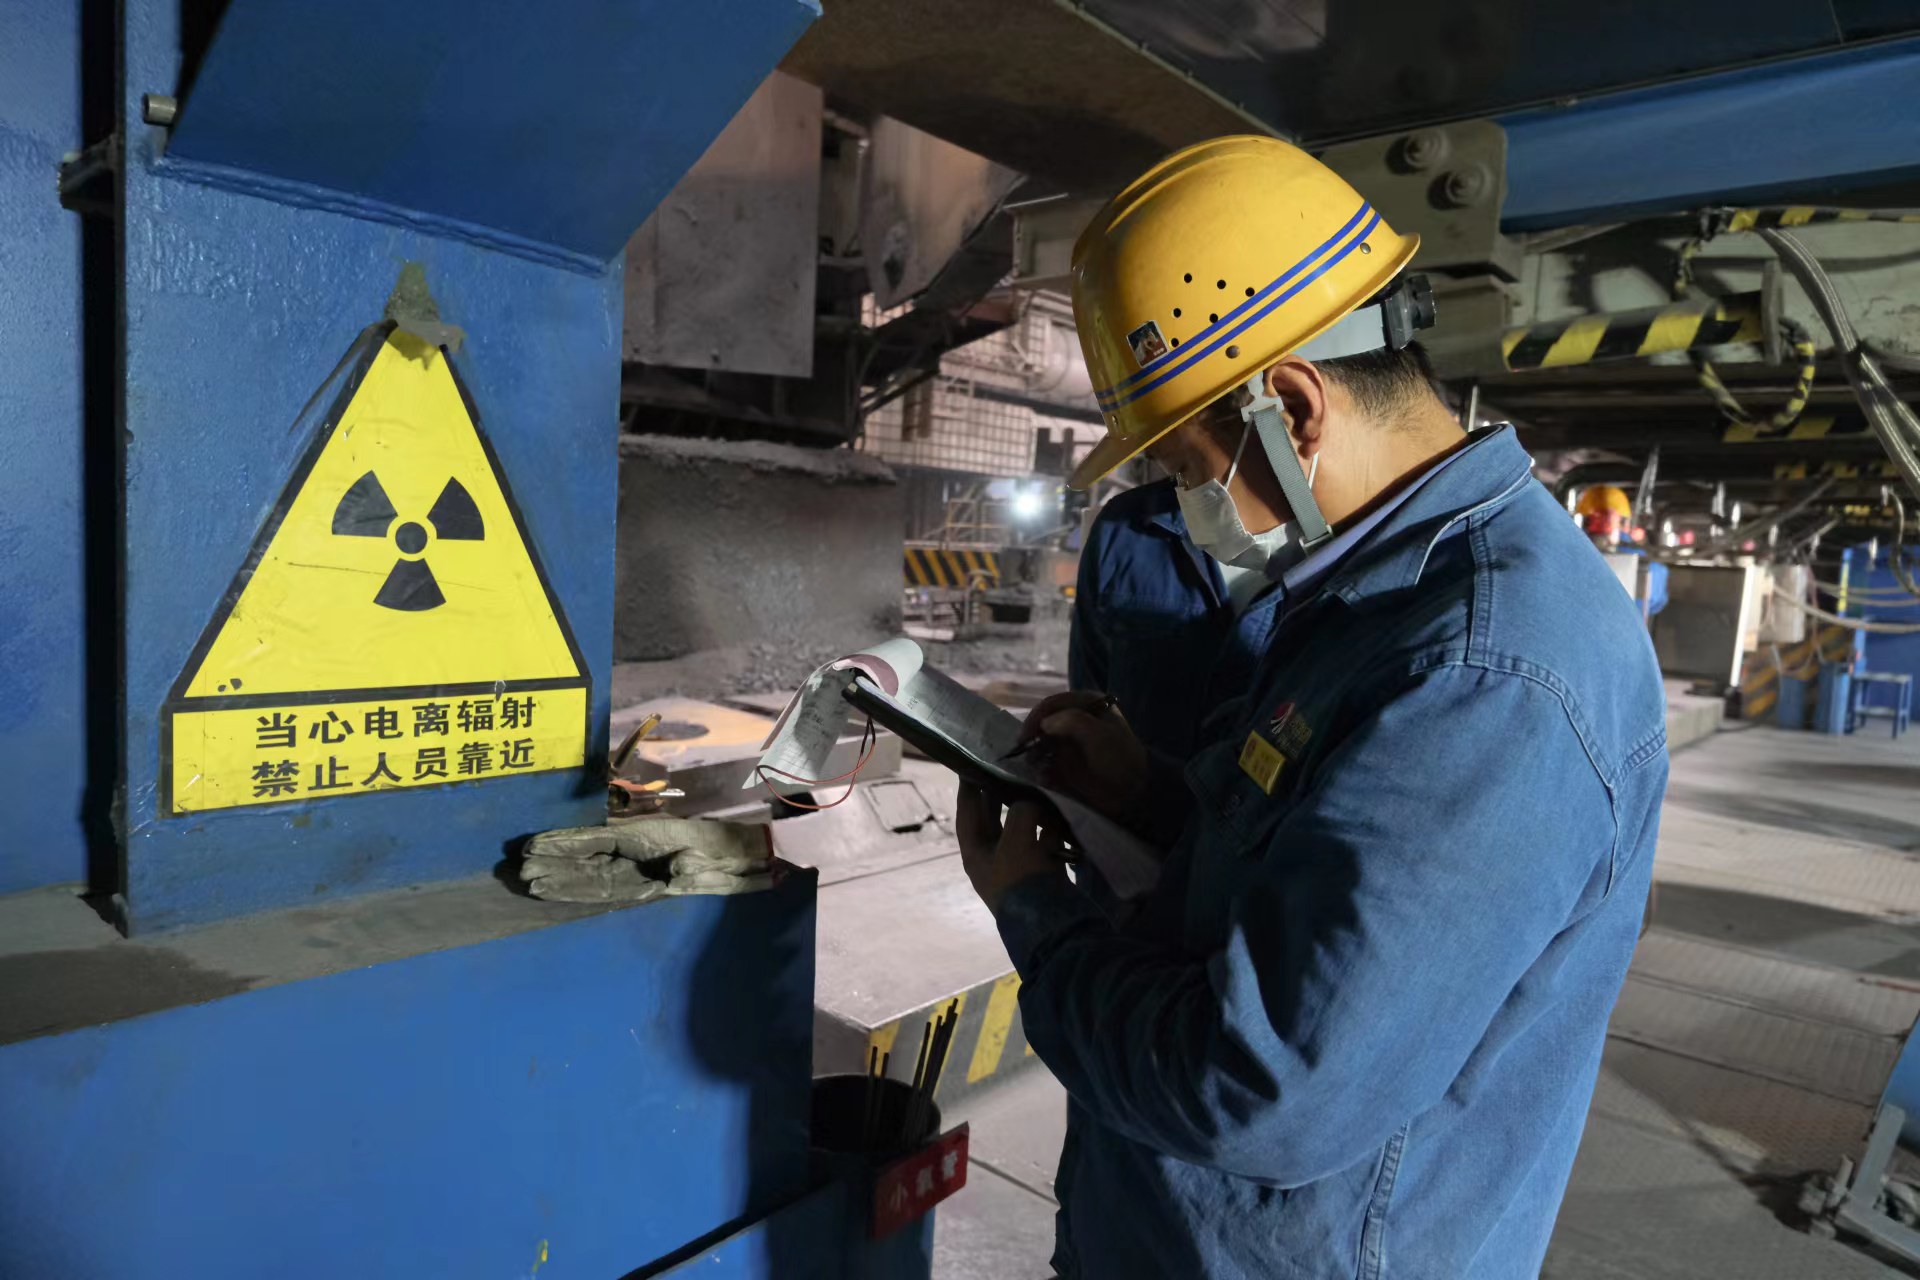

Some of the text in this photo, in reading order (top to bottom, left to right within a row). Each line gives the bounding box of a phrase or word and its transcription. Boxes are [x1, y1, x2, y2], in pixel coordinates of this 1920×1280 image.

[256, 696, 537, 749] 当心电离辐射
[252, 738, 536, 798] 禁止人员靠近
